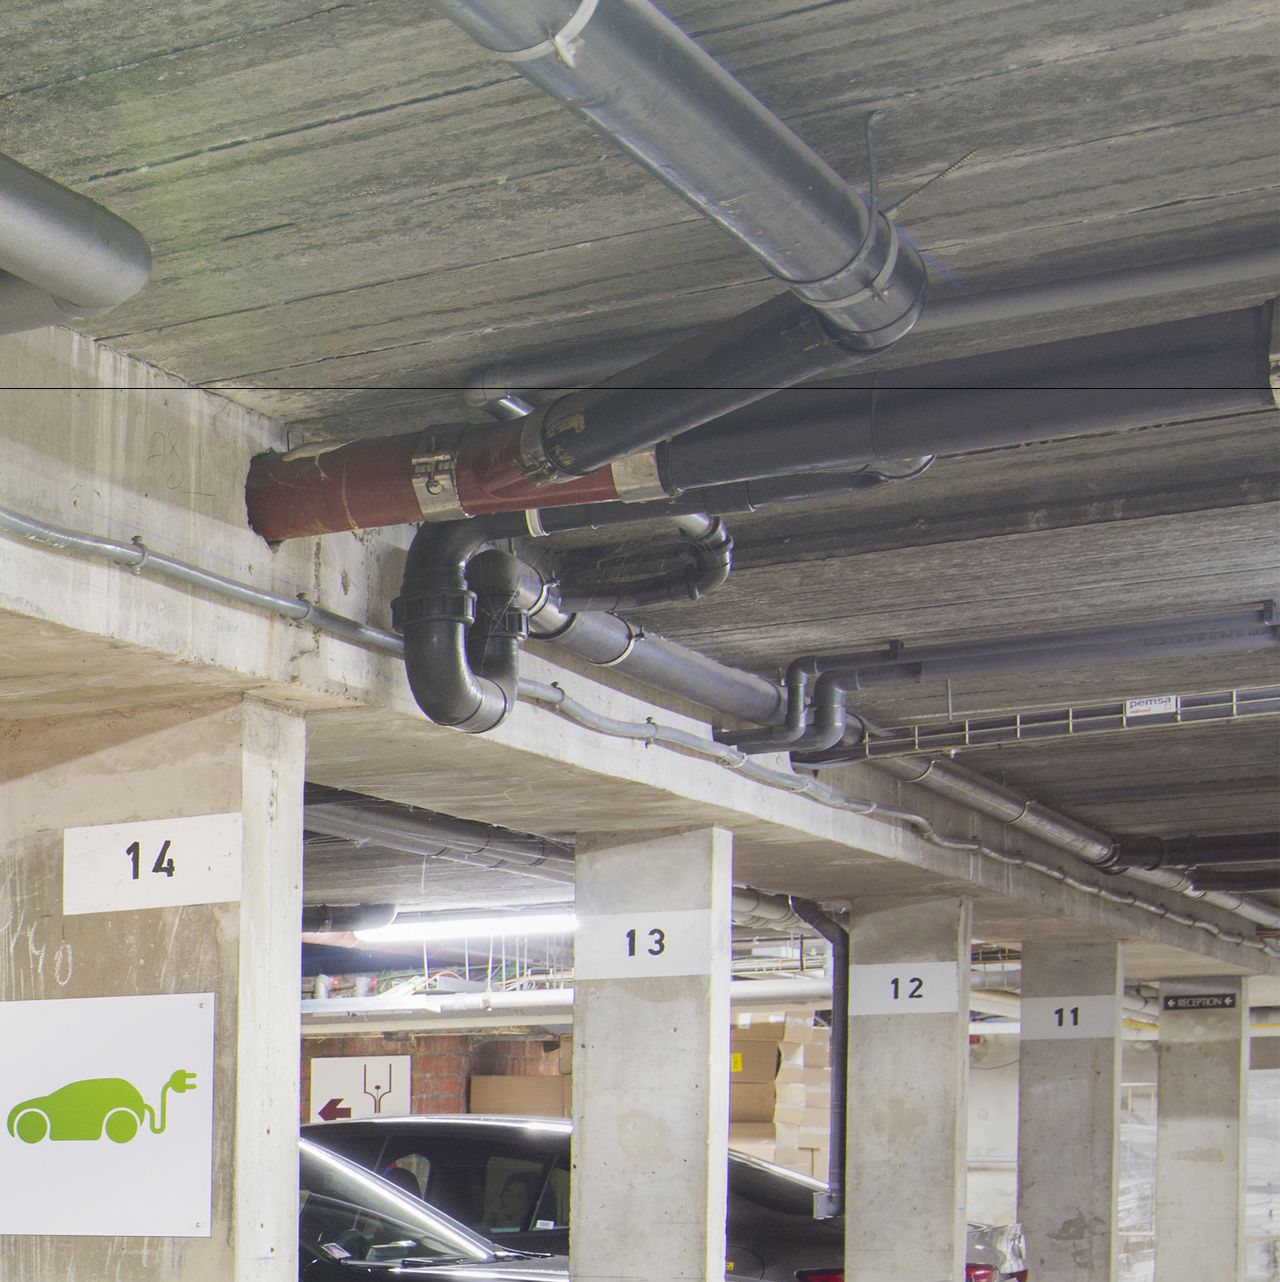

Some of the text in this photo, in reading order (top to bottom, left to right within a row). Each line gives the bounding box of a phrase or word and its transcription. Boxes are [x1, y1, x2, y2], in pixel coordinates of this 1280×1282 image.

[1130, 697, 1171, 709] pemsa
[125, 840, 176, 880] 14
[626, 928, 665, 957] 13
[890, 977, 923, 999] 12
[1177, 997, 1222, 1008] RECEPTION
[1054, 1006, 1079, 1026] 11
